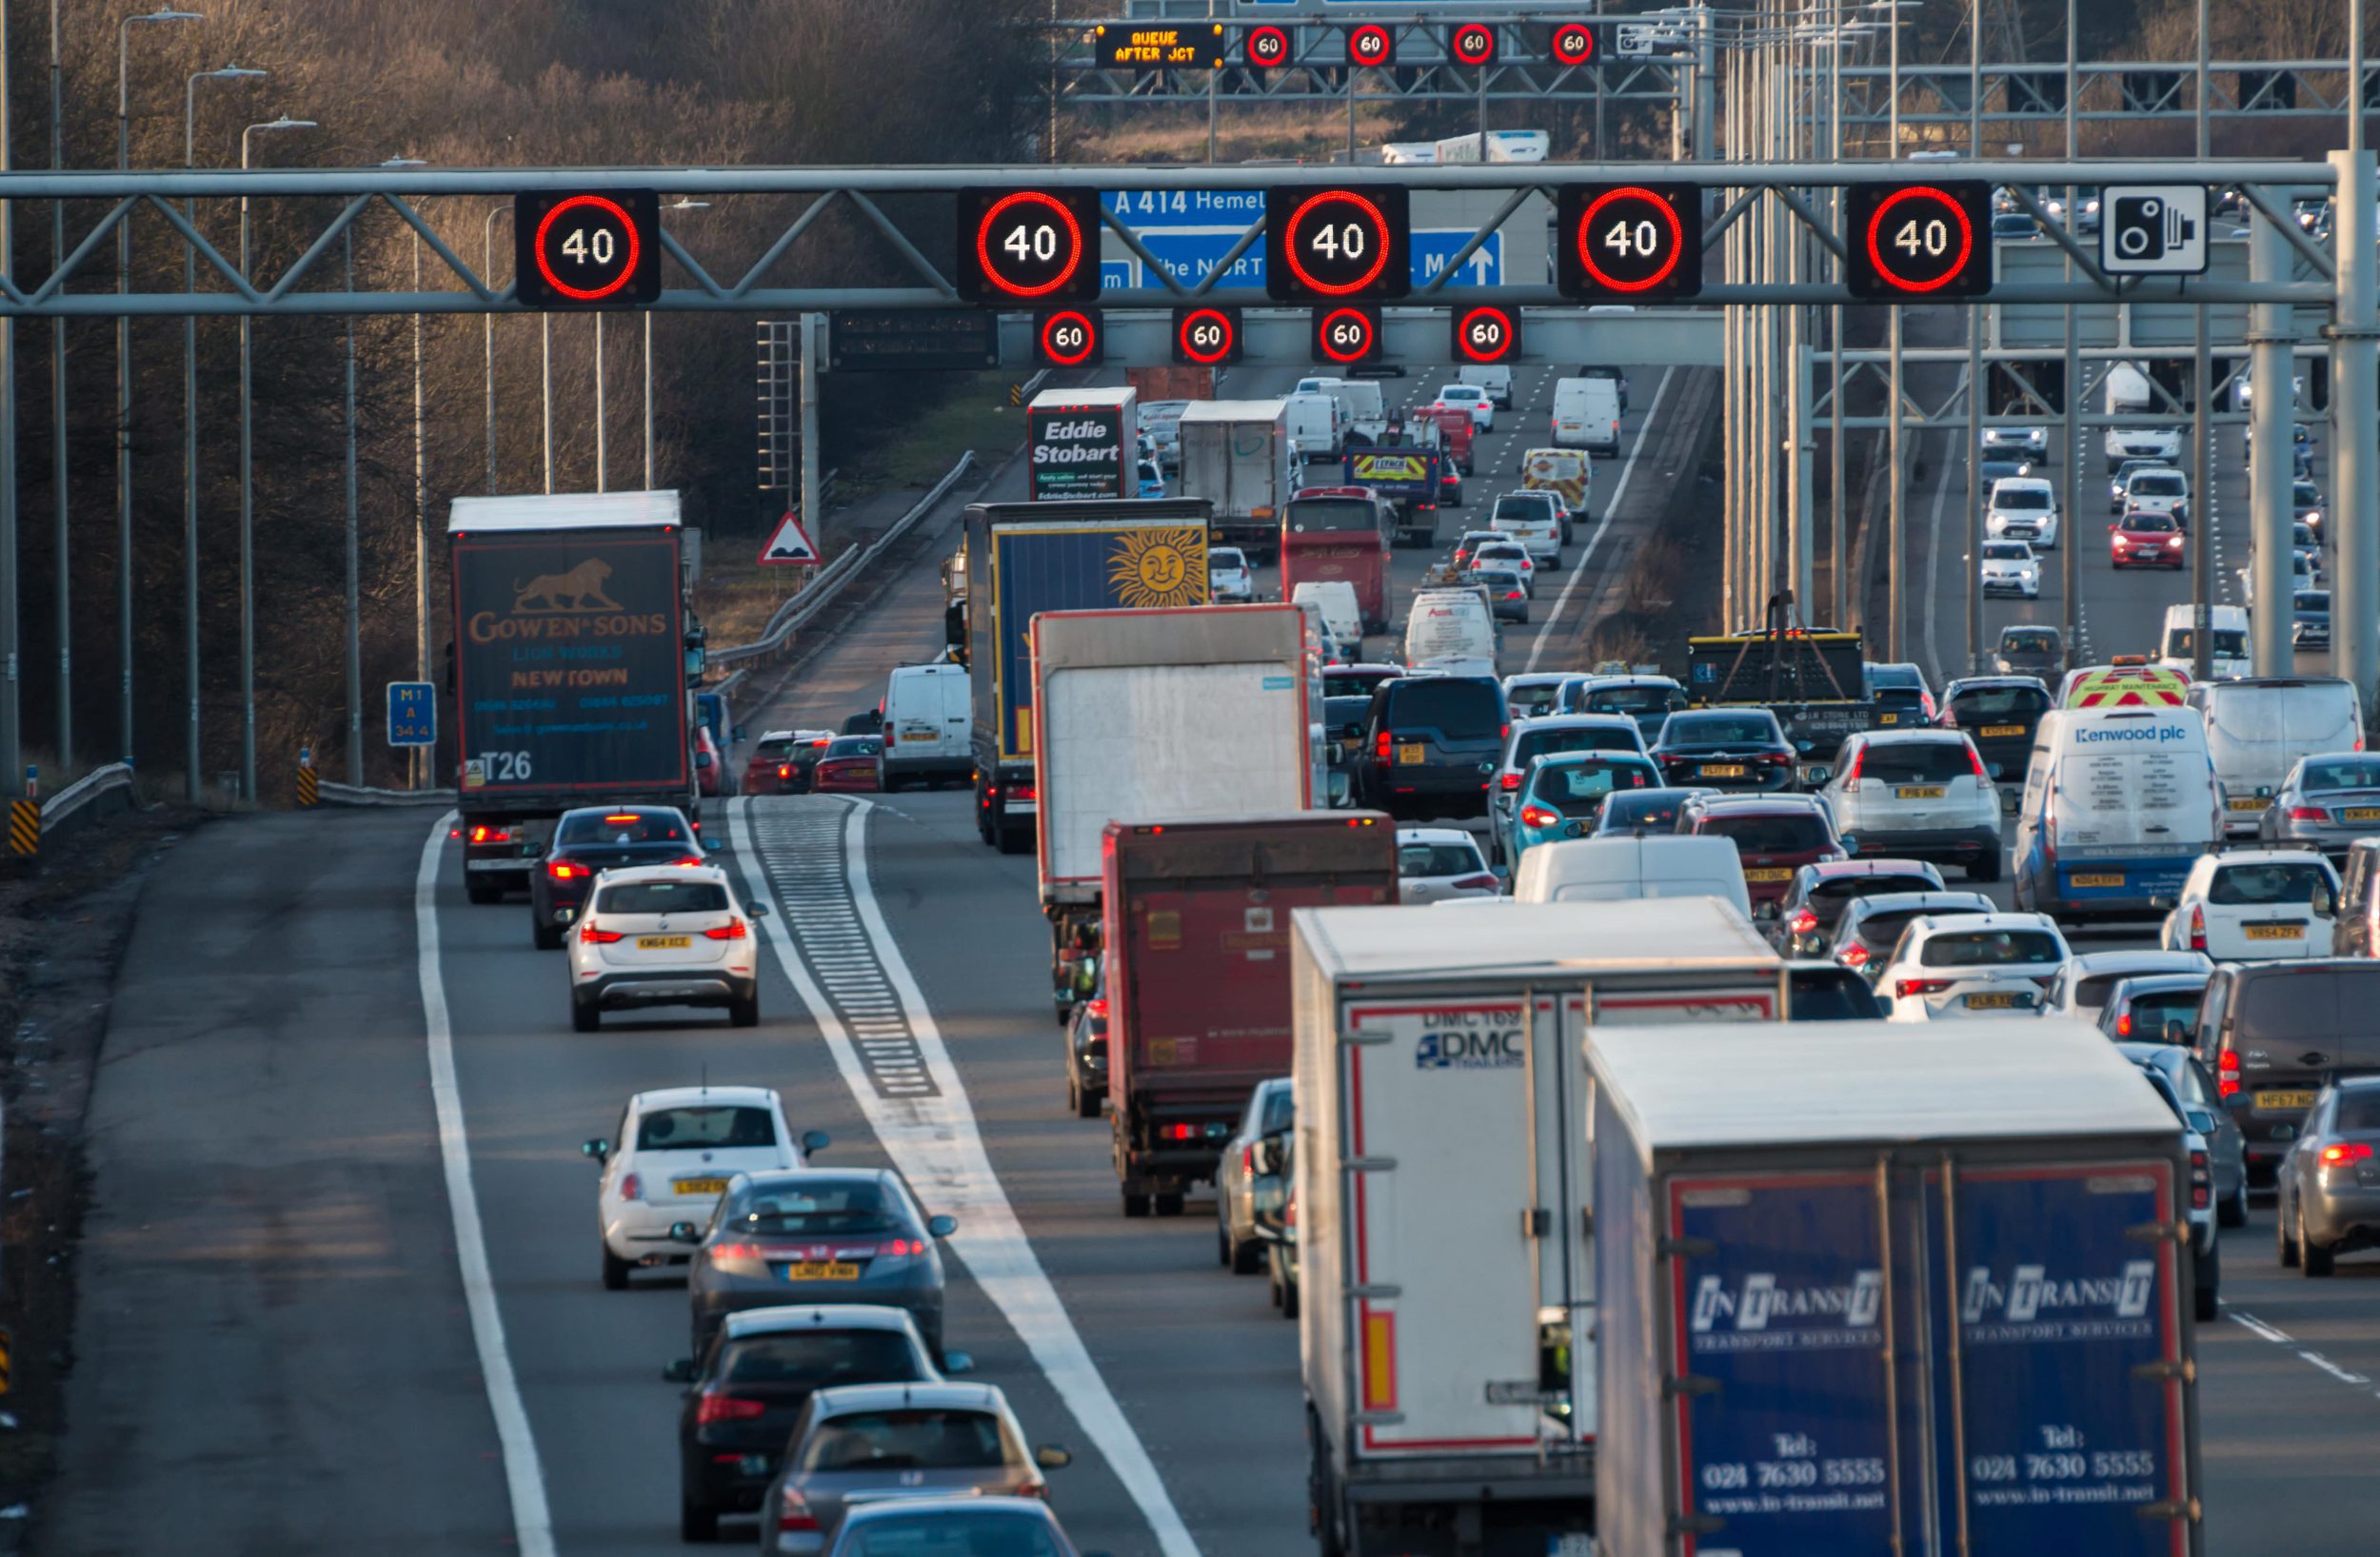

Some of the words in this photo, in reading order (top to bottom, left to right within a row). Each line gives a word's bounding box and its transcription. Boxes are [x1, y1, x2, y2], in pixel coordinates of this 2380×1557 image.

[1131, 31, 1178, 46] QUEUE
[1258, 37, 1279, 53] 60
[1360, 36, 1380, 52] 60
[1464, 35, 1484, 50] 60
[1564, 35, 1584, 50] 60
[1115, 47, 1160, 61] AFTER
[1167, 47, 1195, 61] JCT
[1196, 190, 1266, 209] Hemel
[563, 228, 614, 264] 40
[1003, 225, 1056, 262] 40
[1312, 223, 1364, 260] 40
[1605, 220, 1656, 257] 40
[1895, 219, 1947, 256] 40
[1155, 258, 1189, 276] he
[1056, 327, 1082, 346] 60
[1194, 325, 1220, 345] 60
[1334, 325, 1360, 345] 60
[1472, 324, 1499, 345] 60
[1045, 421, 1107, 441] Eddie
[1033, 443, 1121, 464] Stobart
[593, 614, 666, 637] SONS
[511, 669, 628, 687] NEWTOWN
[407, 707, 415, 719] A
[2075, 726, 2156, 743] Kenwood
[2159, 725, 2187, 742] plc
[481, 752, 531, 779] T26
[1441, 1030, 1523, 1057] DMC
[1775, 1432, 1816, 1458] Tel:
[2040, 1424, 2085, 1449] Tel:
[1703, 1463, 1748, 1488] 024
[1756, 1461, 1817, 1487] 7630
[1824, 1458, 1885, 1486] 5555
[1973, 1454, 2017, 1481] 024
[2025, 1452, 2086, 1479] 7630
[2092, 1449, 2154, 1477] 5555
[1706, 1491, 1885, 1515] www.in-transit.net
[1975, 1482, 2154, 1506] www.in-transit.net
